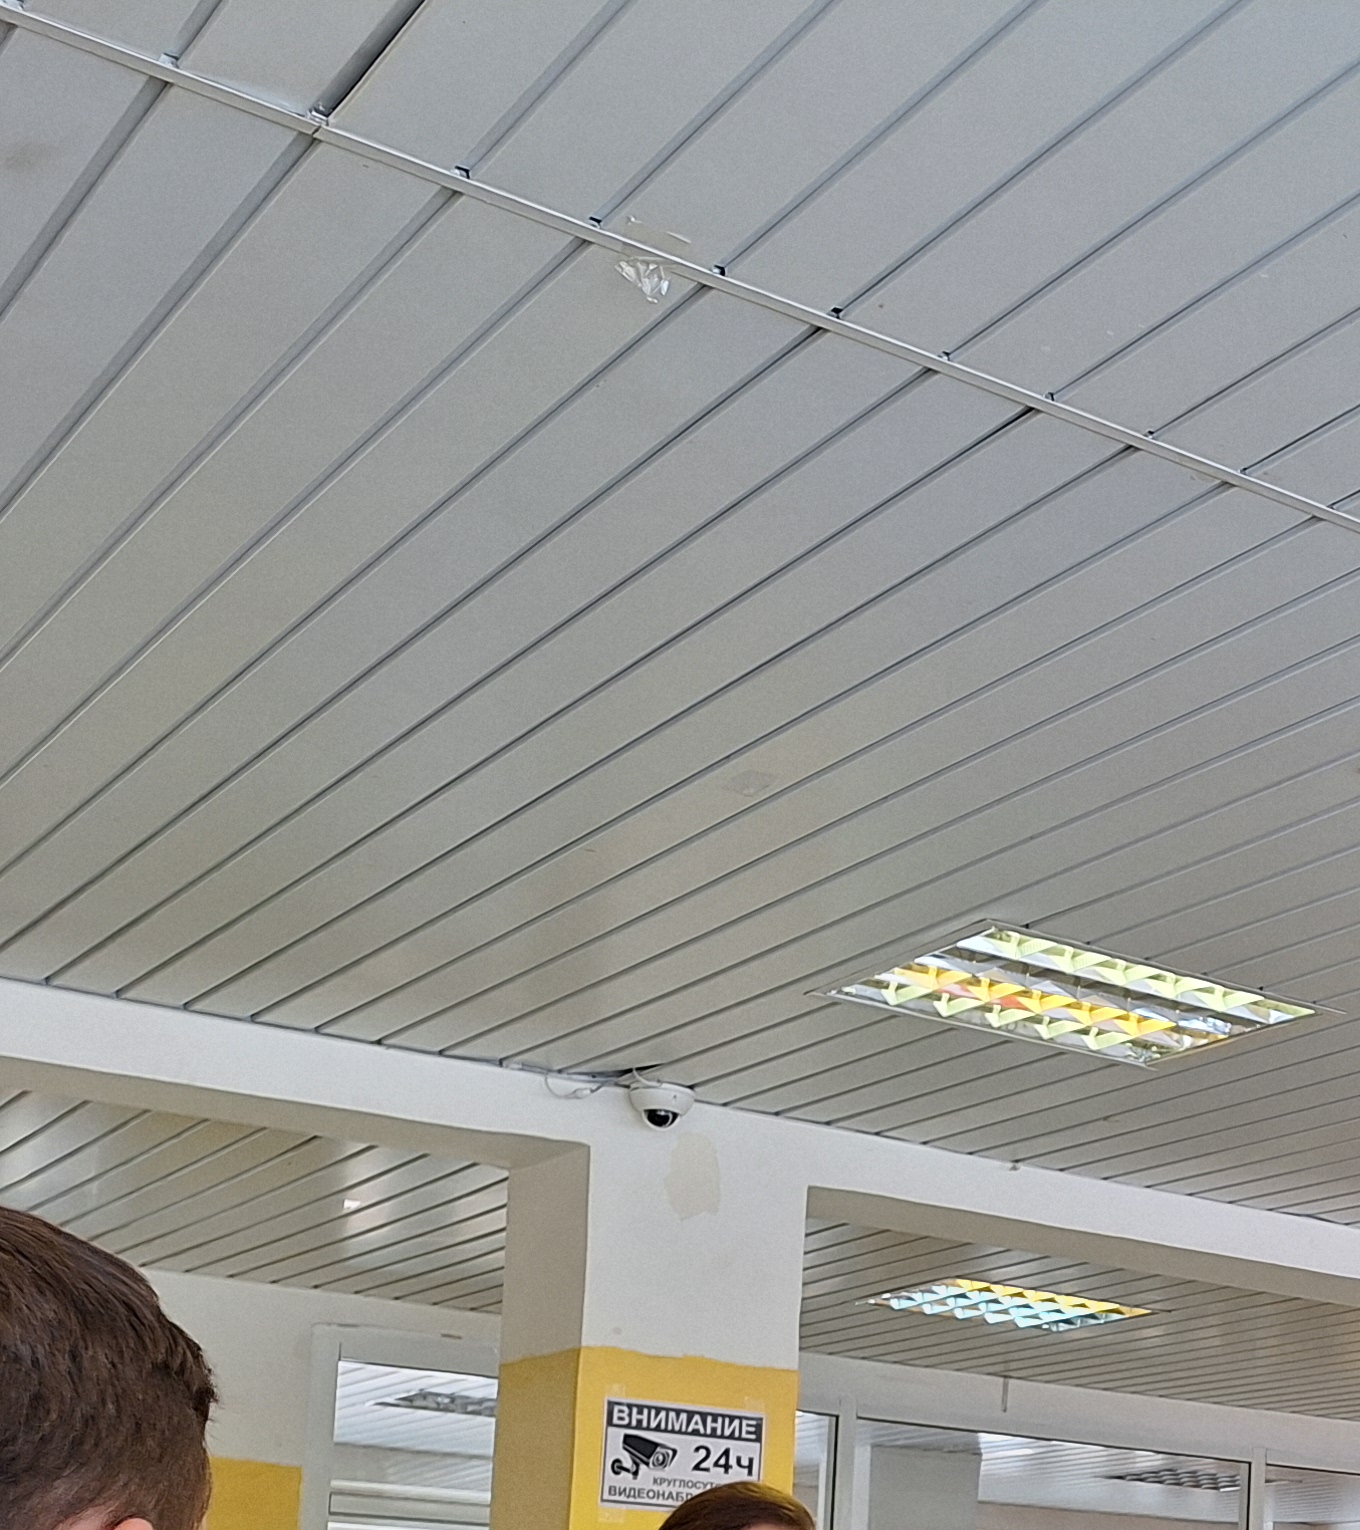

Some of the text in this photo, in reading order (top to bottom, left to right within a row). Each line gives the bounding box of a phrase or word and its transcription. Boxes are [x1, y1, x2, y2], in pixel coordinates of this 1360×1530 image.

[612, 1404, 757, 1439] ВНИМАНИЕ
[691, 1445, 754, 1477] 24ч
[652, 1476, 721, 1491] КРУГЛОСУТ
